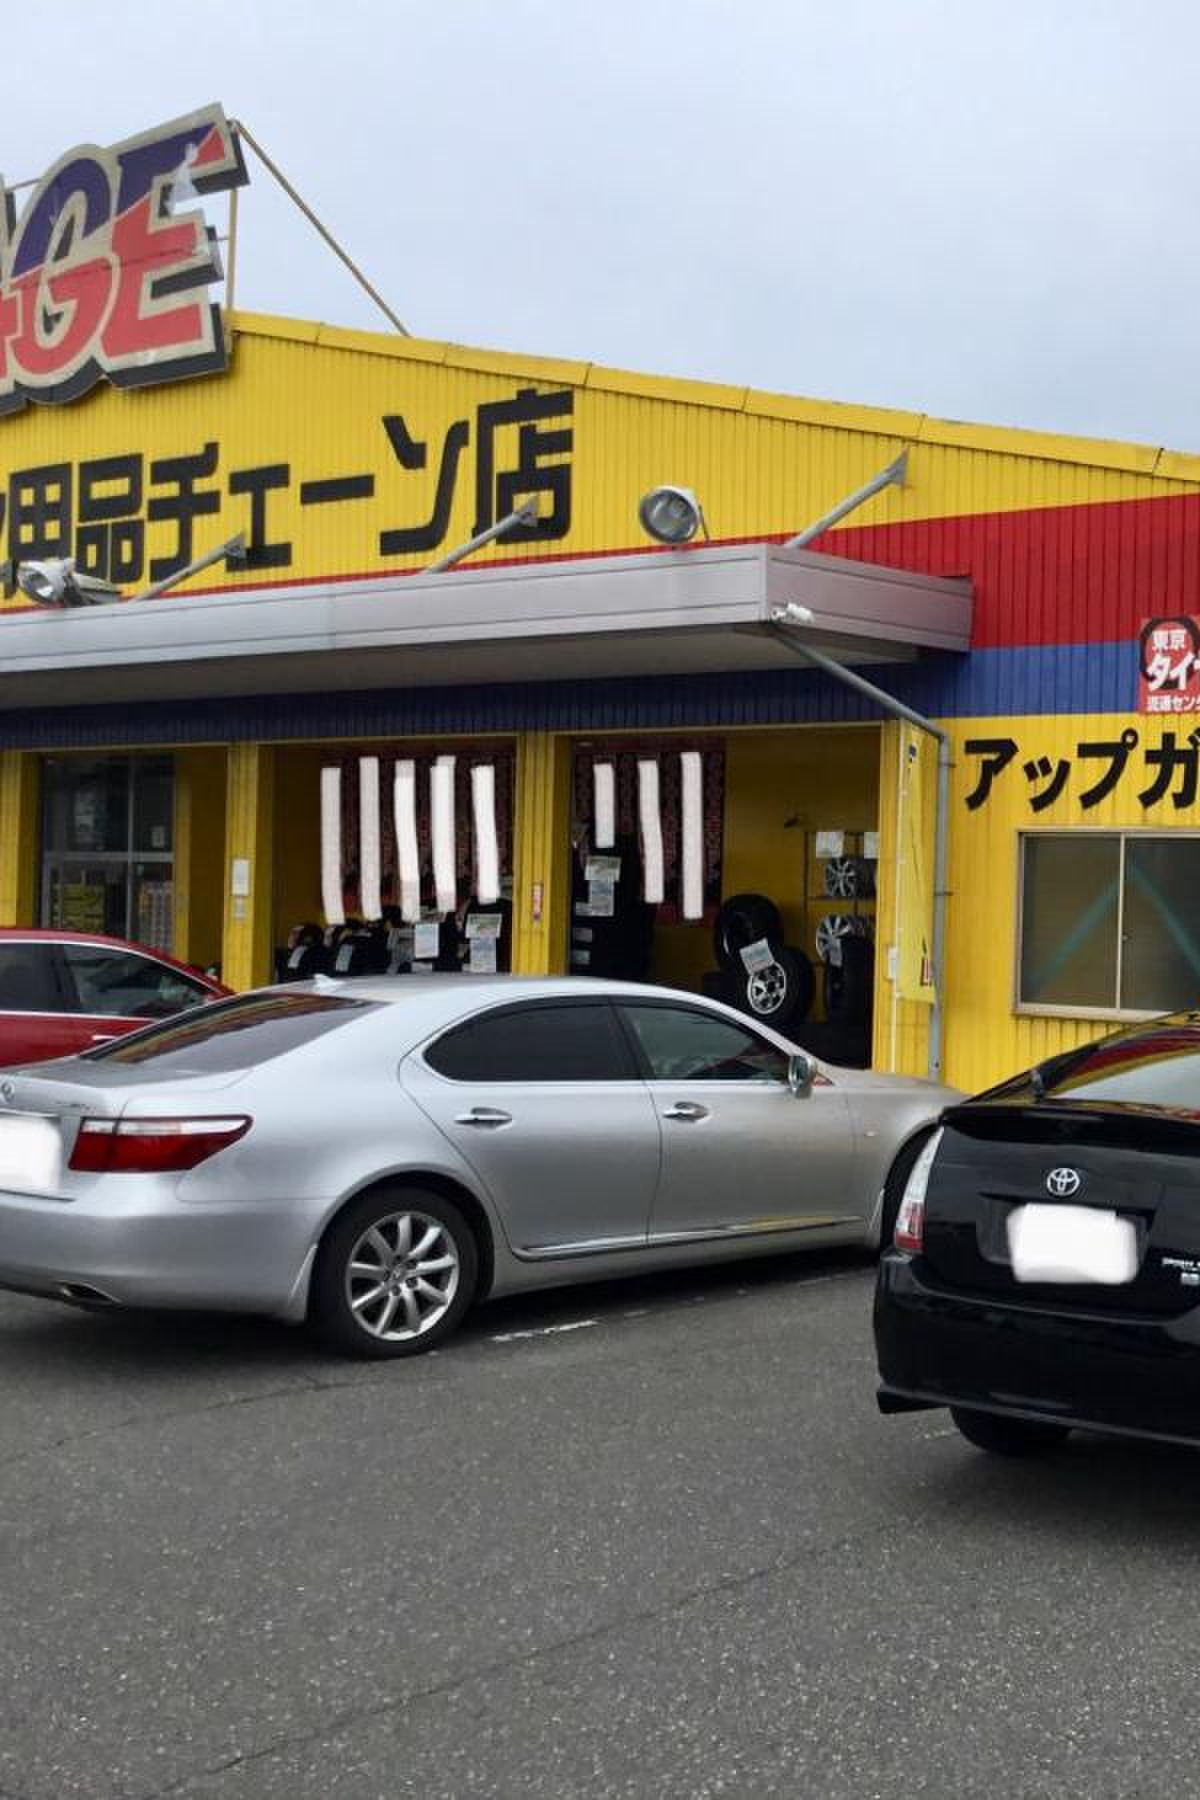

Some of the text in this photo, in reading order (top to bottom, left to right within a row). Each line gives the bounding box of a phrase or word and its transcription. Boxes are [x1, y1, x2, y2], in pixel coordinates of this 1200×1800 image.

[0, 388, 574, 590] 用品チェーン店
